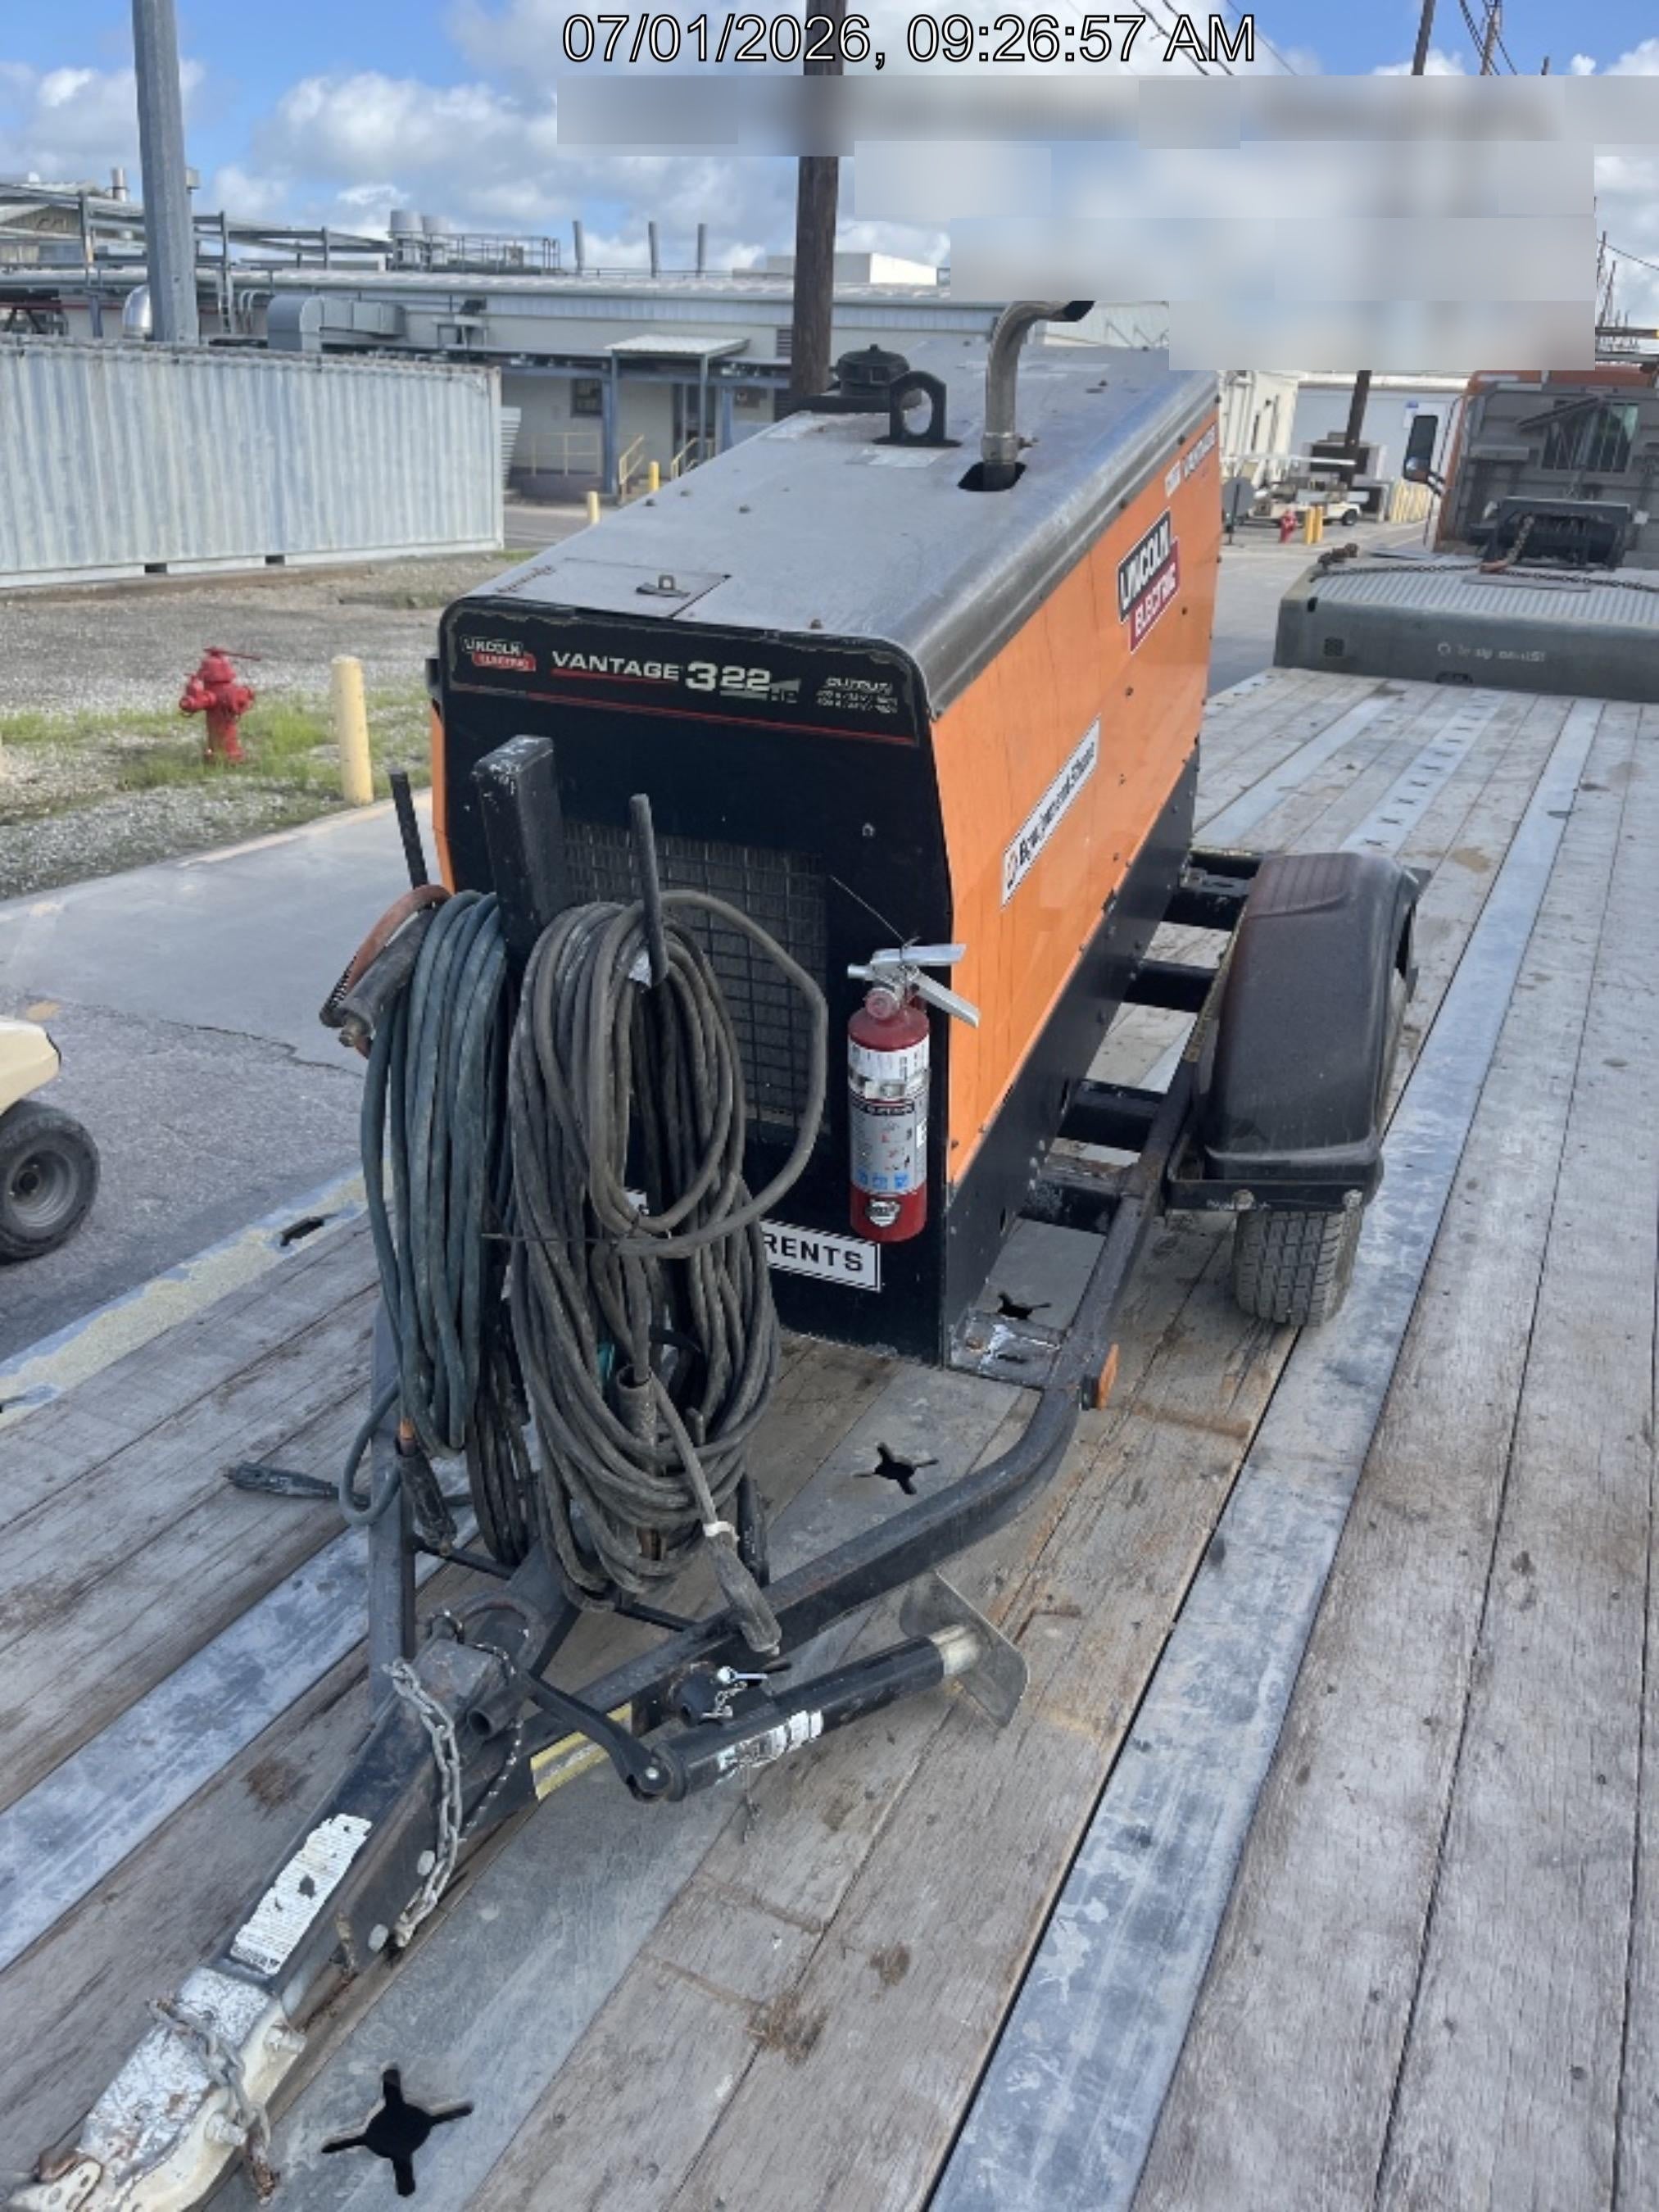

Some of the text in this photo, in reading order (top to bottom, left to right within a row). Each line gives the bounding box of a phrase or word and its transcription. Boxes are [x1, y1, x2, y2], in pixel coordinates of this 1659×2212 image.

[1120, 519, 1169, 611] LINCOLN
[551, 650, 772, 692] VANTAGE 322
